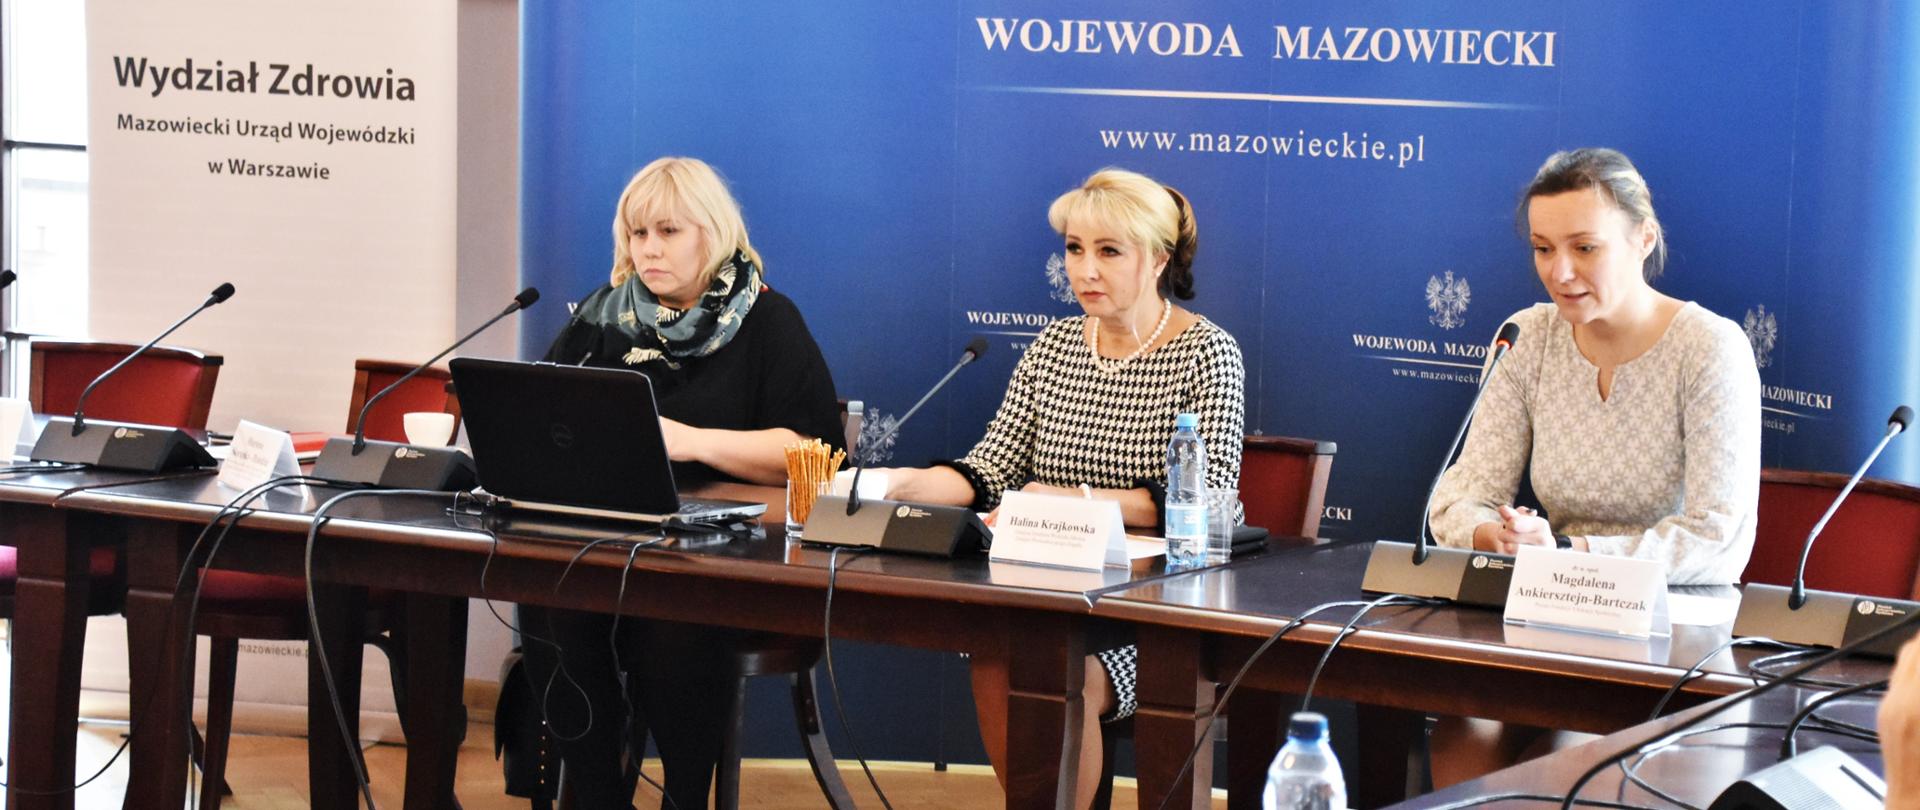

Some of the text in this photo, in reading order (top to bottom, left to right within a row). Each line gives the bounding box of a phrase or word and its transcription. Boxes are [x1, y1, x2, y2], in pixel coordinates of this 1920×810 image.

[975, 17, 1557, 67] WOJEWODA MAZOWIECKI
[113, 56, 416, 101] Wydział Zdrowia
[117, 113, 415, 145] Mazowiecki Urząd Wojewódzki
[1099, 130, 1425, 168] www.mazowieckie.pl
[208, 158, 331, 180] w Warszawie
[1352, 334, 1437, 354] WOJEWODA
[1392, 367, 1481, 384] www.mazowiecki
[1010, 516, 1096, 534] Halina Krajkowska
[1552, 573, 1616, 591] Magdalena
[1515, 587, 1646, 611] Ankiersztejn-Bartczak
